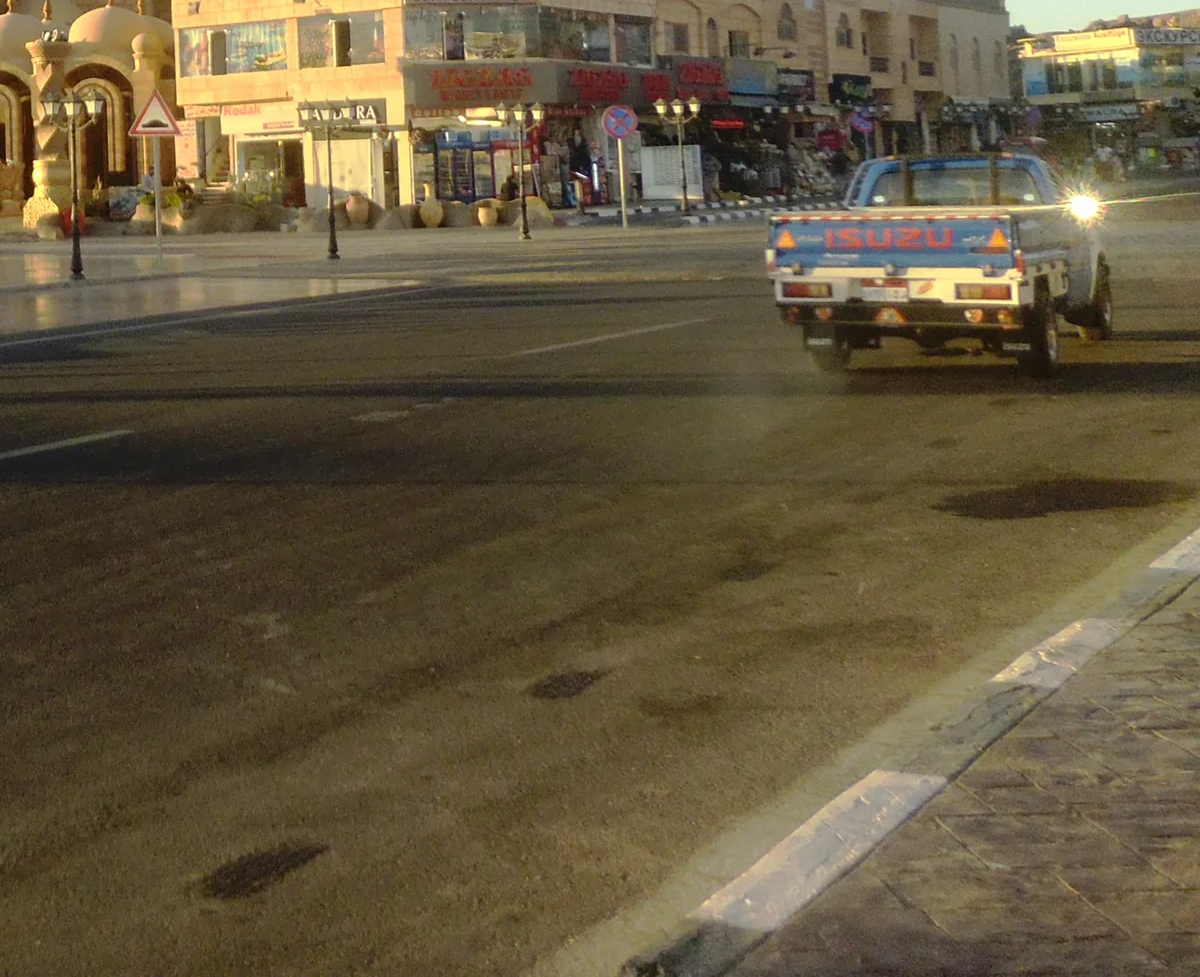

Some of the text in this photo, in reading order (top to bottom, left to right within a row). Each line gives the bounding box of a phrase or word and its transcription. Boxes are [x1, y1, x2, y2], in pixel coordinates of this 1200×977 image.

[1136, 29, 1200, 43] ЭКСКУРС
[223, 104, 261, 116] Kodak
[825, 227, 953, 250] ISUZU
